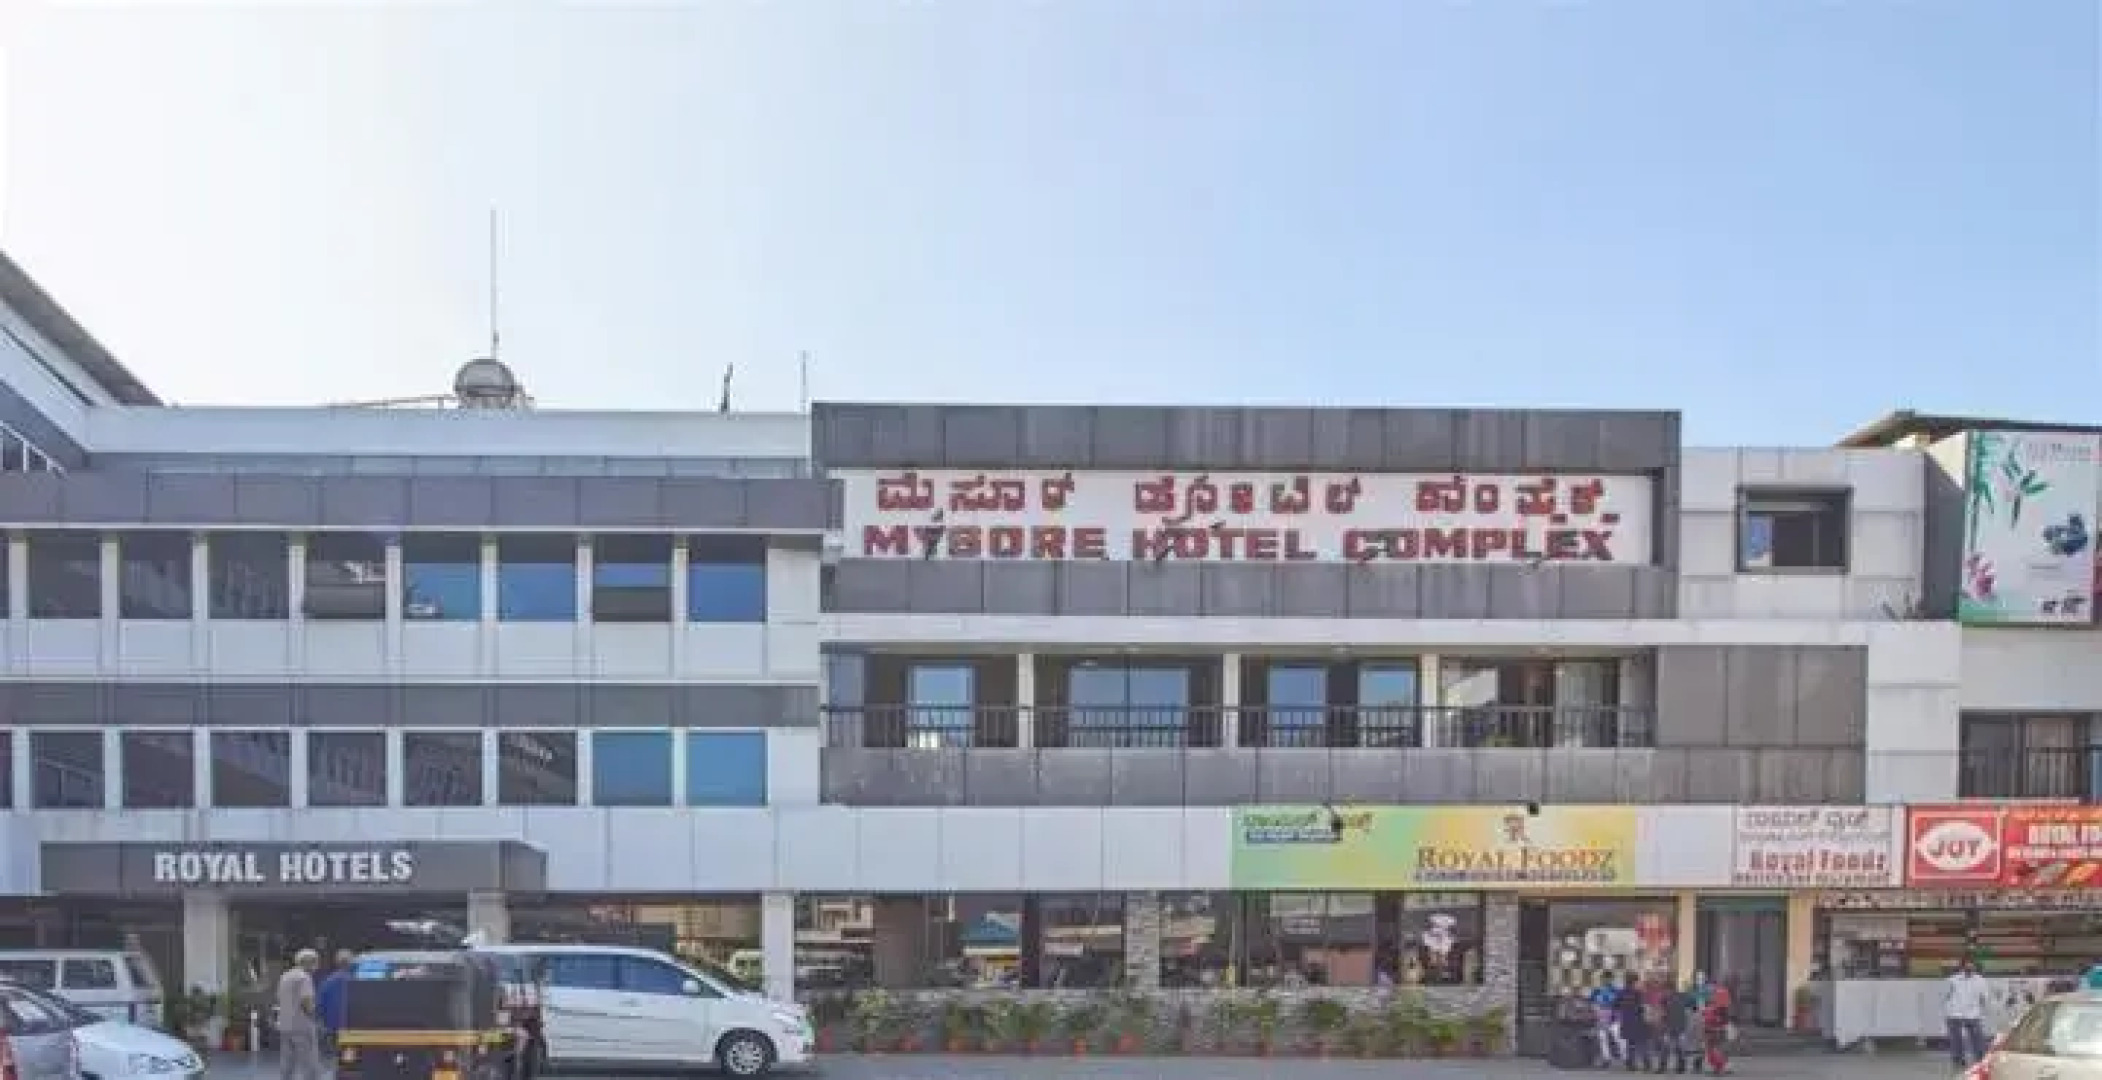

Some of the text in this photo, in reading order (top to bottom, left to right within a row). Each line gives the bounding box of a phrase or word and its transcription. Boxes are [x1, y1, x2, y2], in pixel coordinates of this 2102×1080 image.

[863, 526, 1613, 561] MYSORE HOTEL COMPLEX
[154, 850, 413, 883] ROYAL HOTELS
